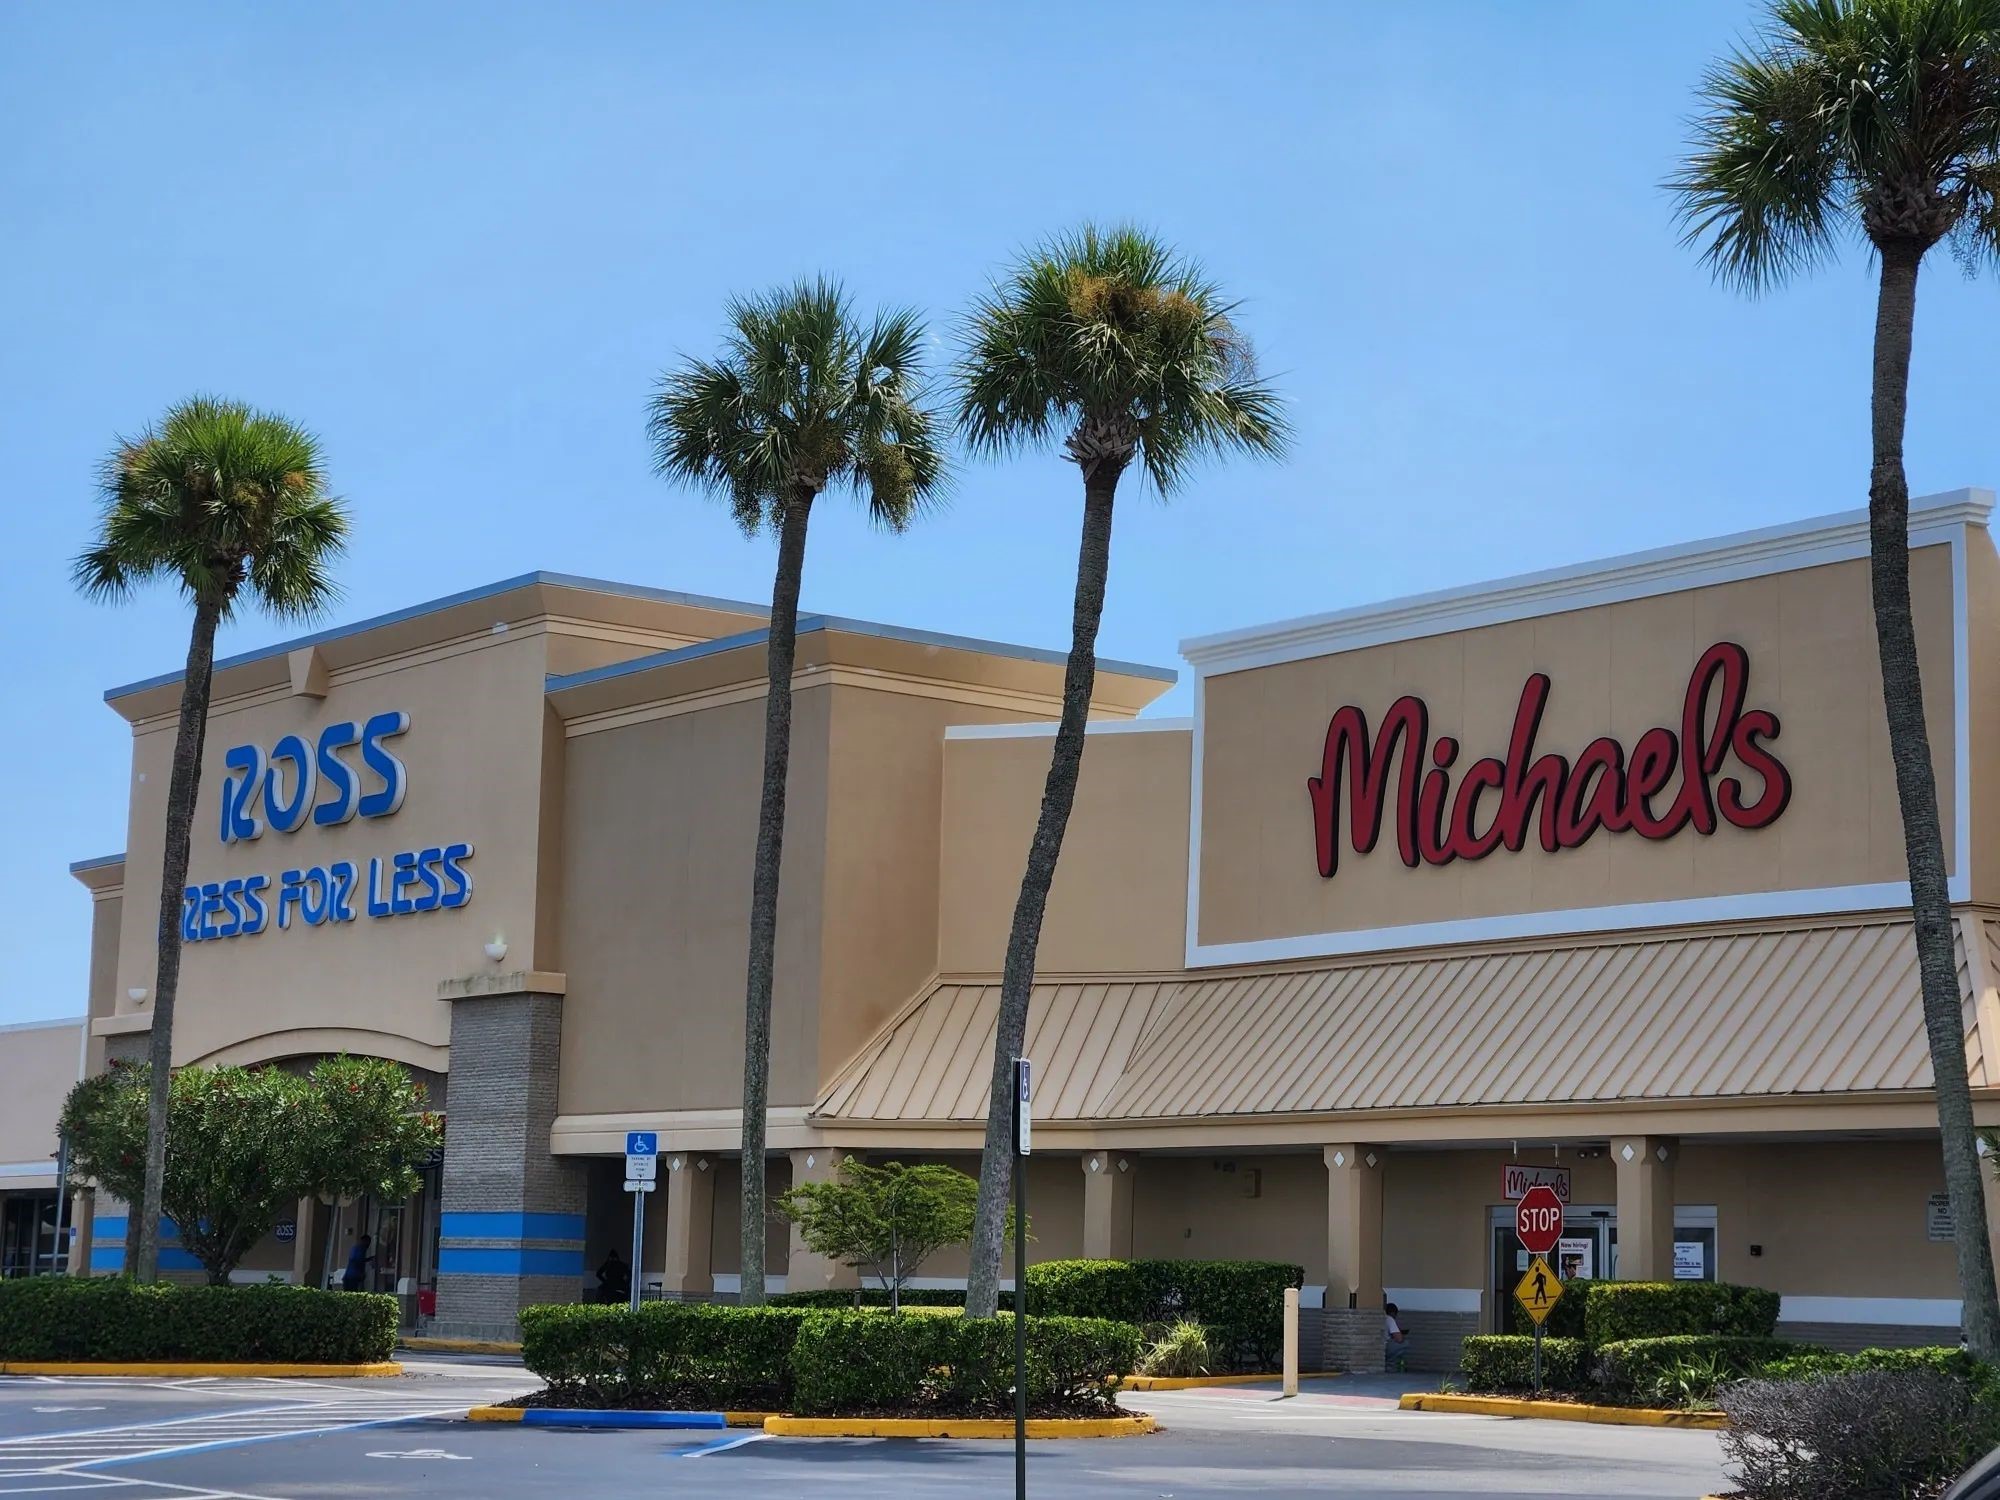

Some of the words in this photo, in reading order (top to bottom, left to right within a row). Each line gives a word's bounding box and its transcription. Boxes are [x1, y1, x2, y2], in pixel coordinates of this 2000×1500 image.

[220, 711, 410, 843] ROSS
[1307, 642, 1792, 878] Michaels
[181, 875, 271, 942] RESS
[278, 862, 359, 929] FOR
[368, 843, 474, 917] LESS
[1519, 1207, 1560, 1233] STOP
